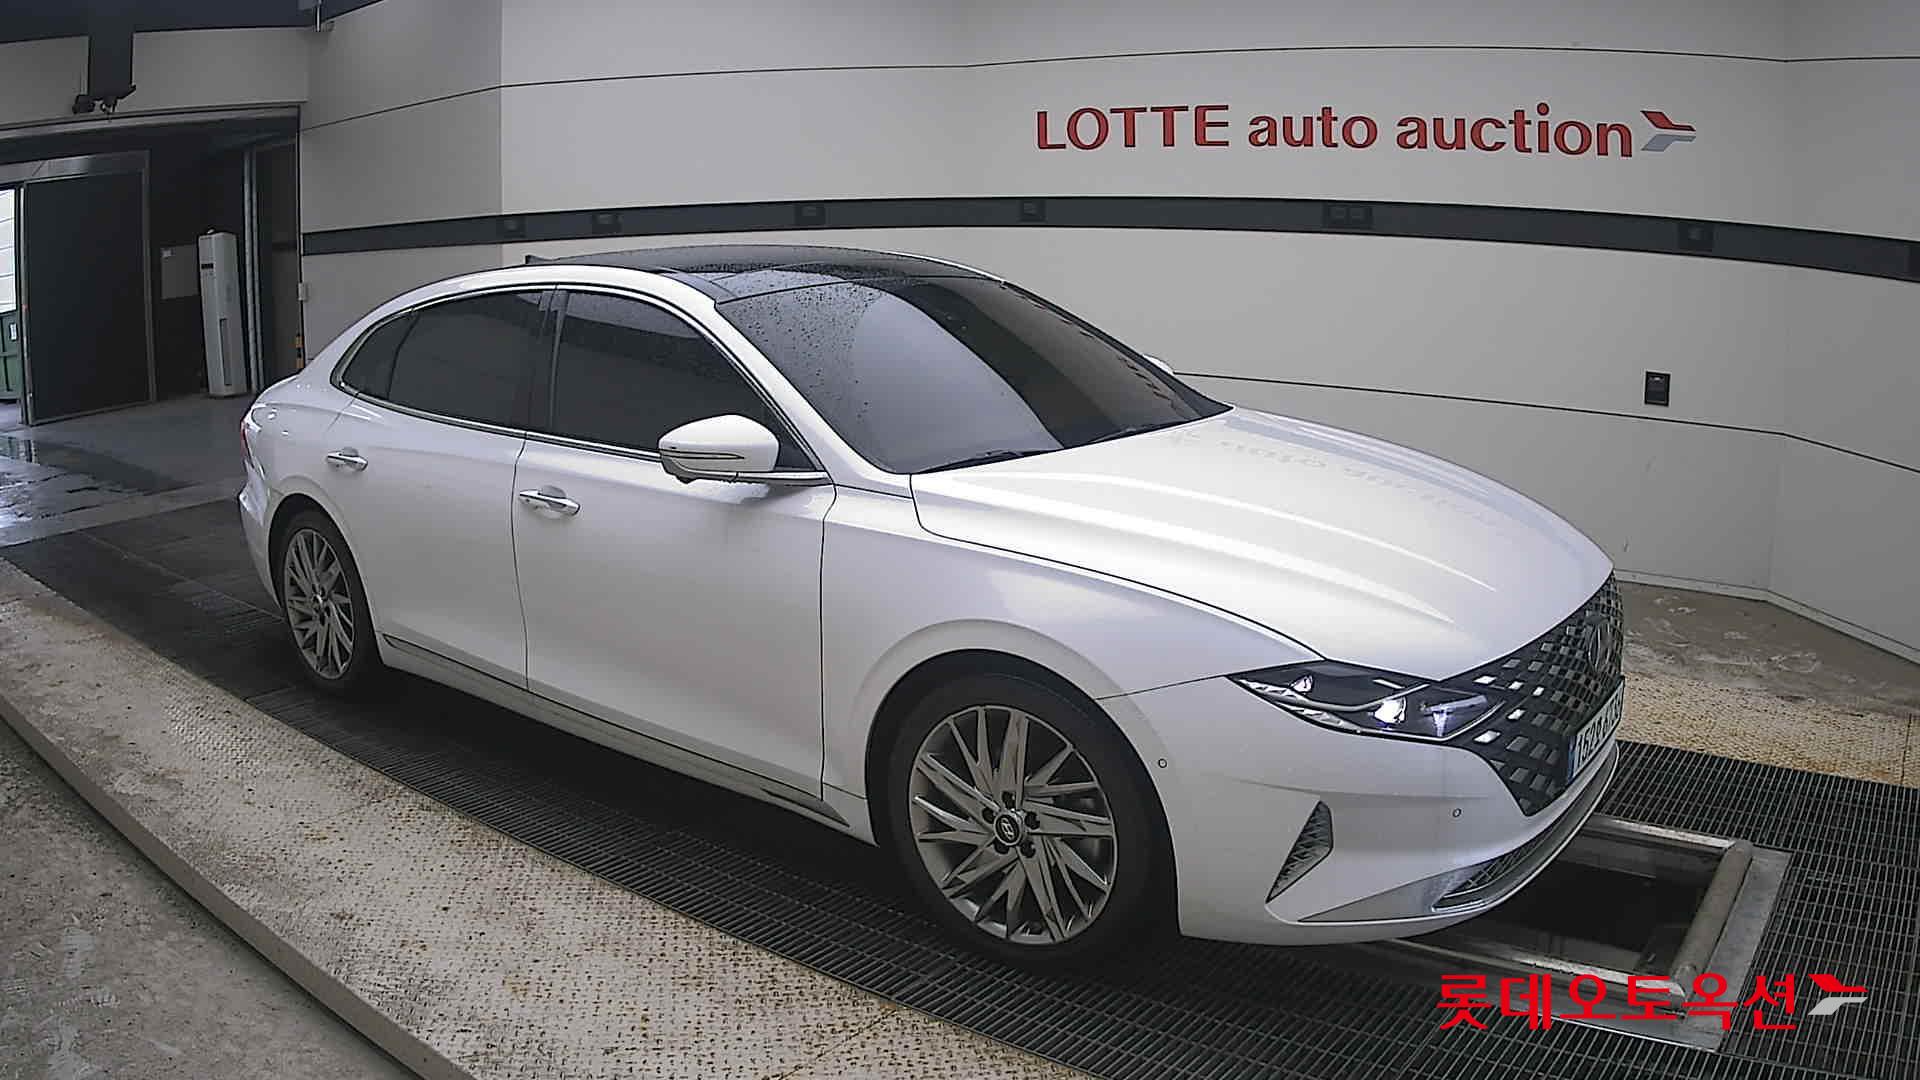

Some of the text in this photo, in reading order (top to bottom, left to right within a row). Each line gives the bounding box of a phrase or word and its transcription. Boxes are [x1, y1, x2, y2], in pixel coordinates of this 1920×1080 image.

[1037, 103, 1633, 157] LOTTE auto auction
